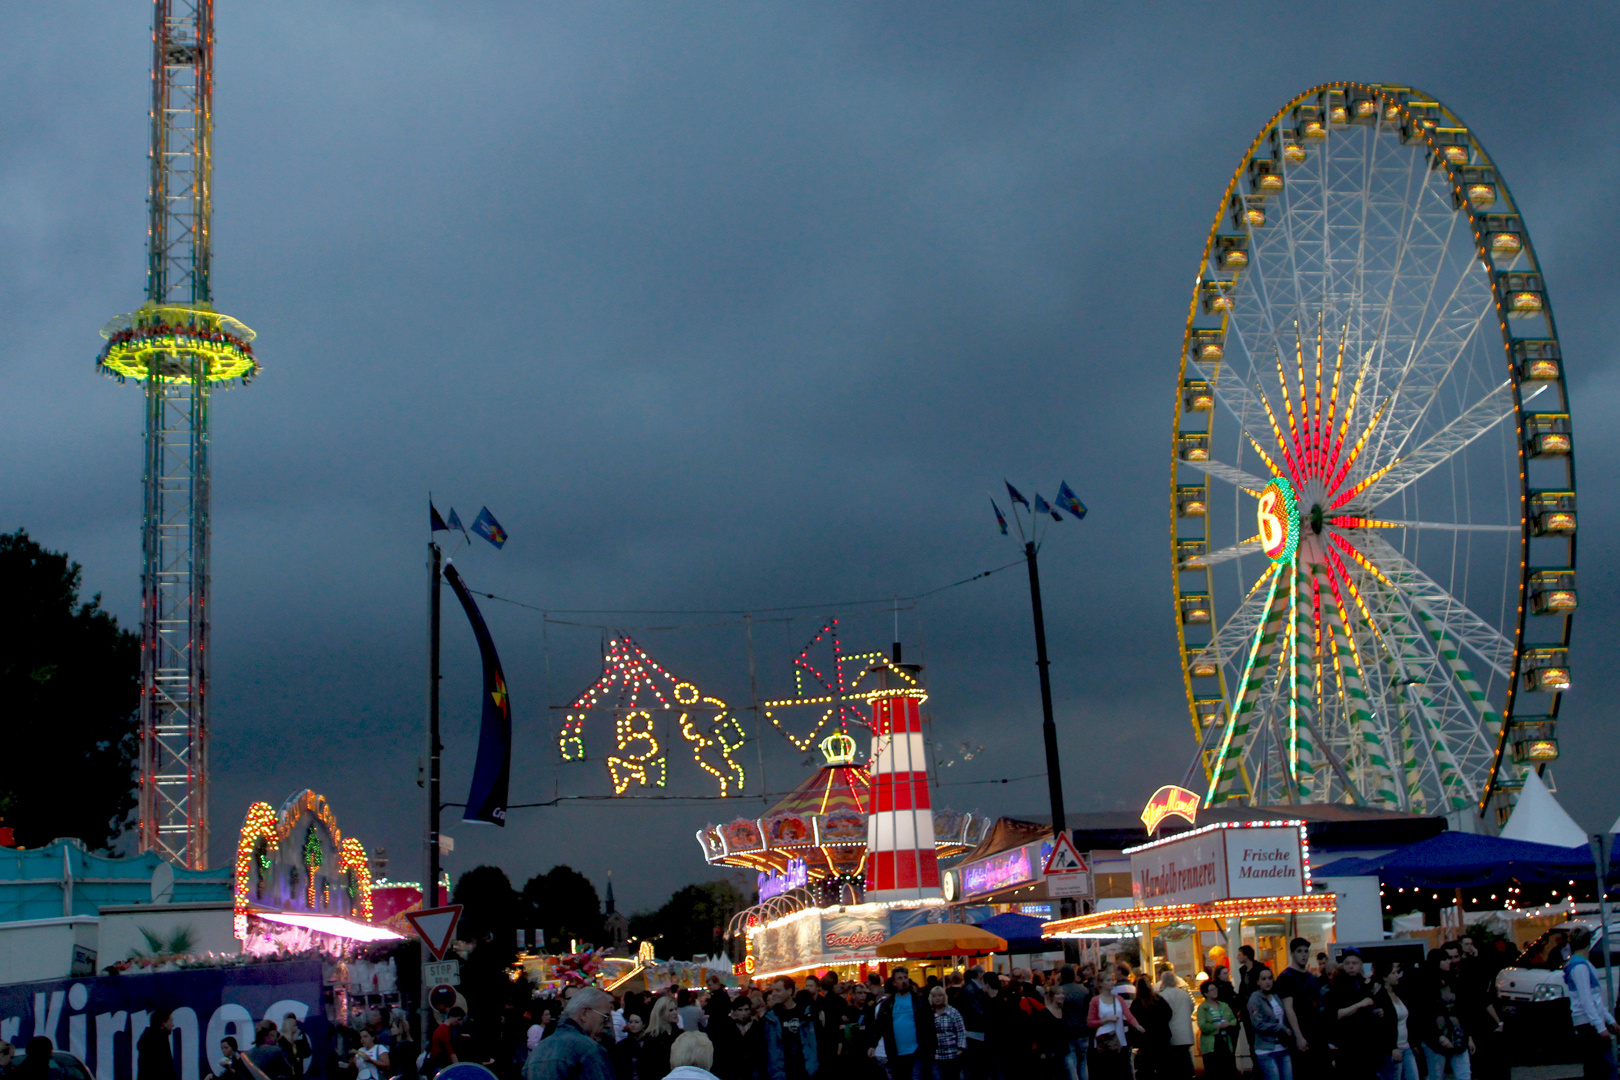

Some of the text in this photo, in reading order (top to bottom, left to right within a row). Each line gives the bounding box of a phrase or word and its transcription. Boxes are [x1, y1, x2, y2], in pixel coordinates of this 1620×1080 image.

[1258, 492, 1282, 552] B
[1242, 848, 1291, 862] Frische
[1140, 851, 1216, 899] Mandelbrennerei
[1238, 864, 1296, 879] Mandeln
[825, 931, 884, 948] Backfisch
[430, 964, 451, 976] STOP
